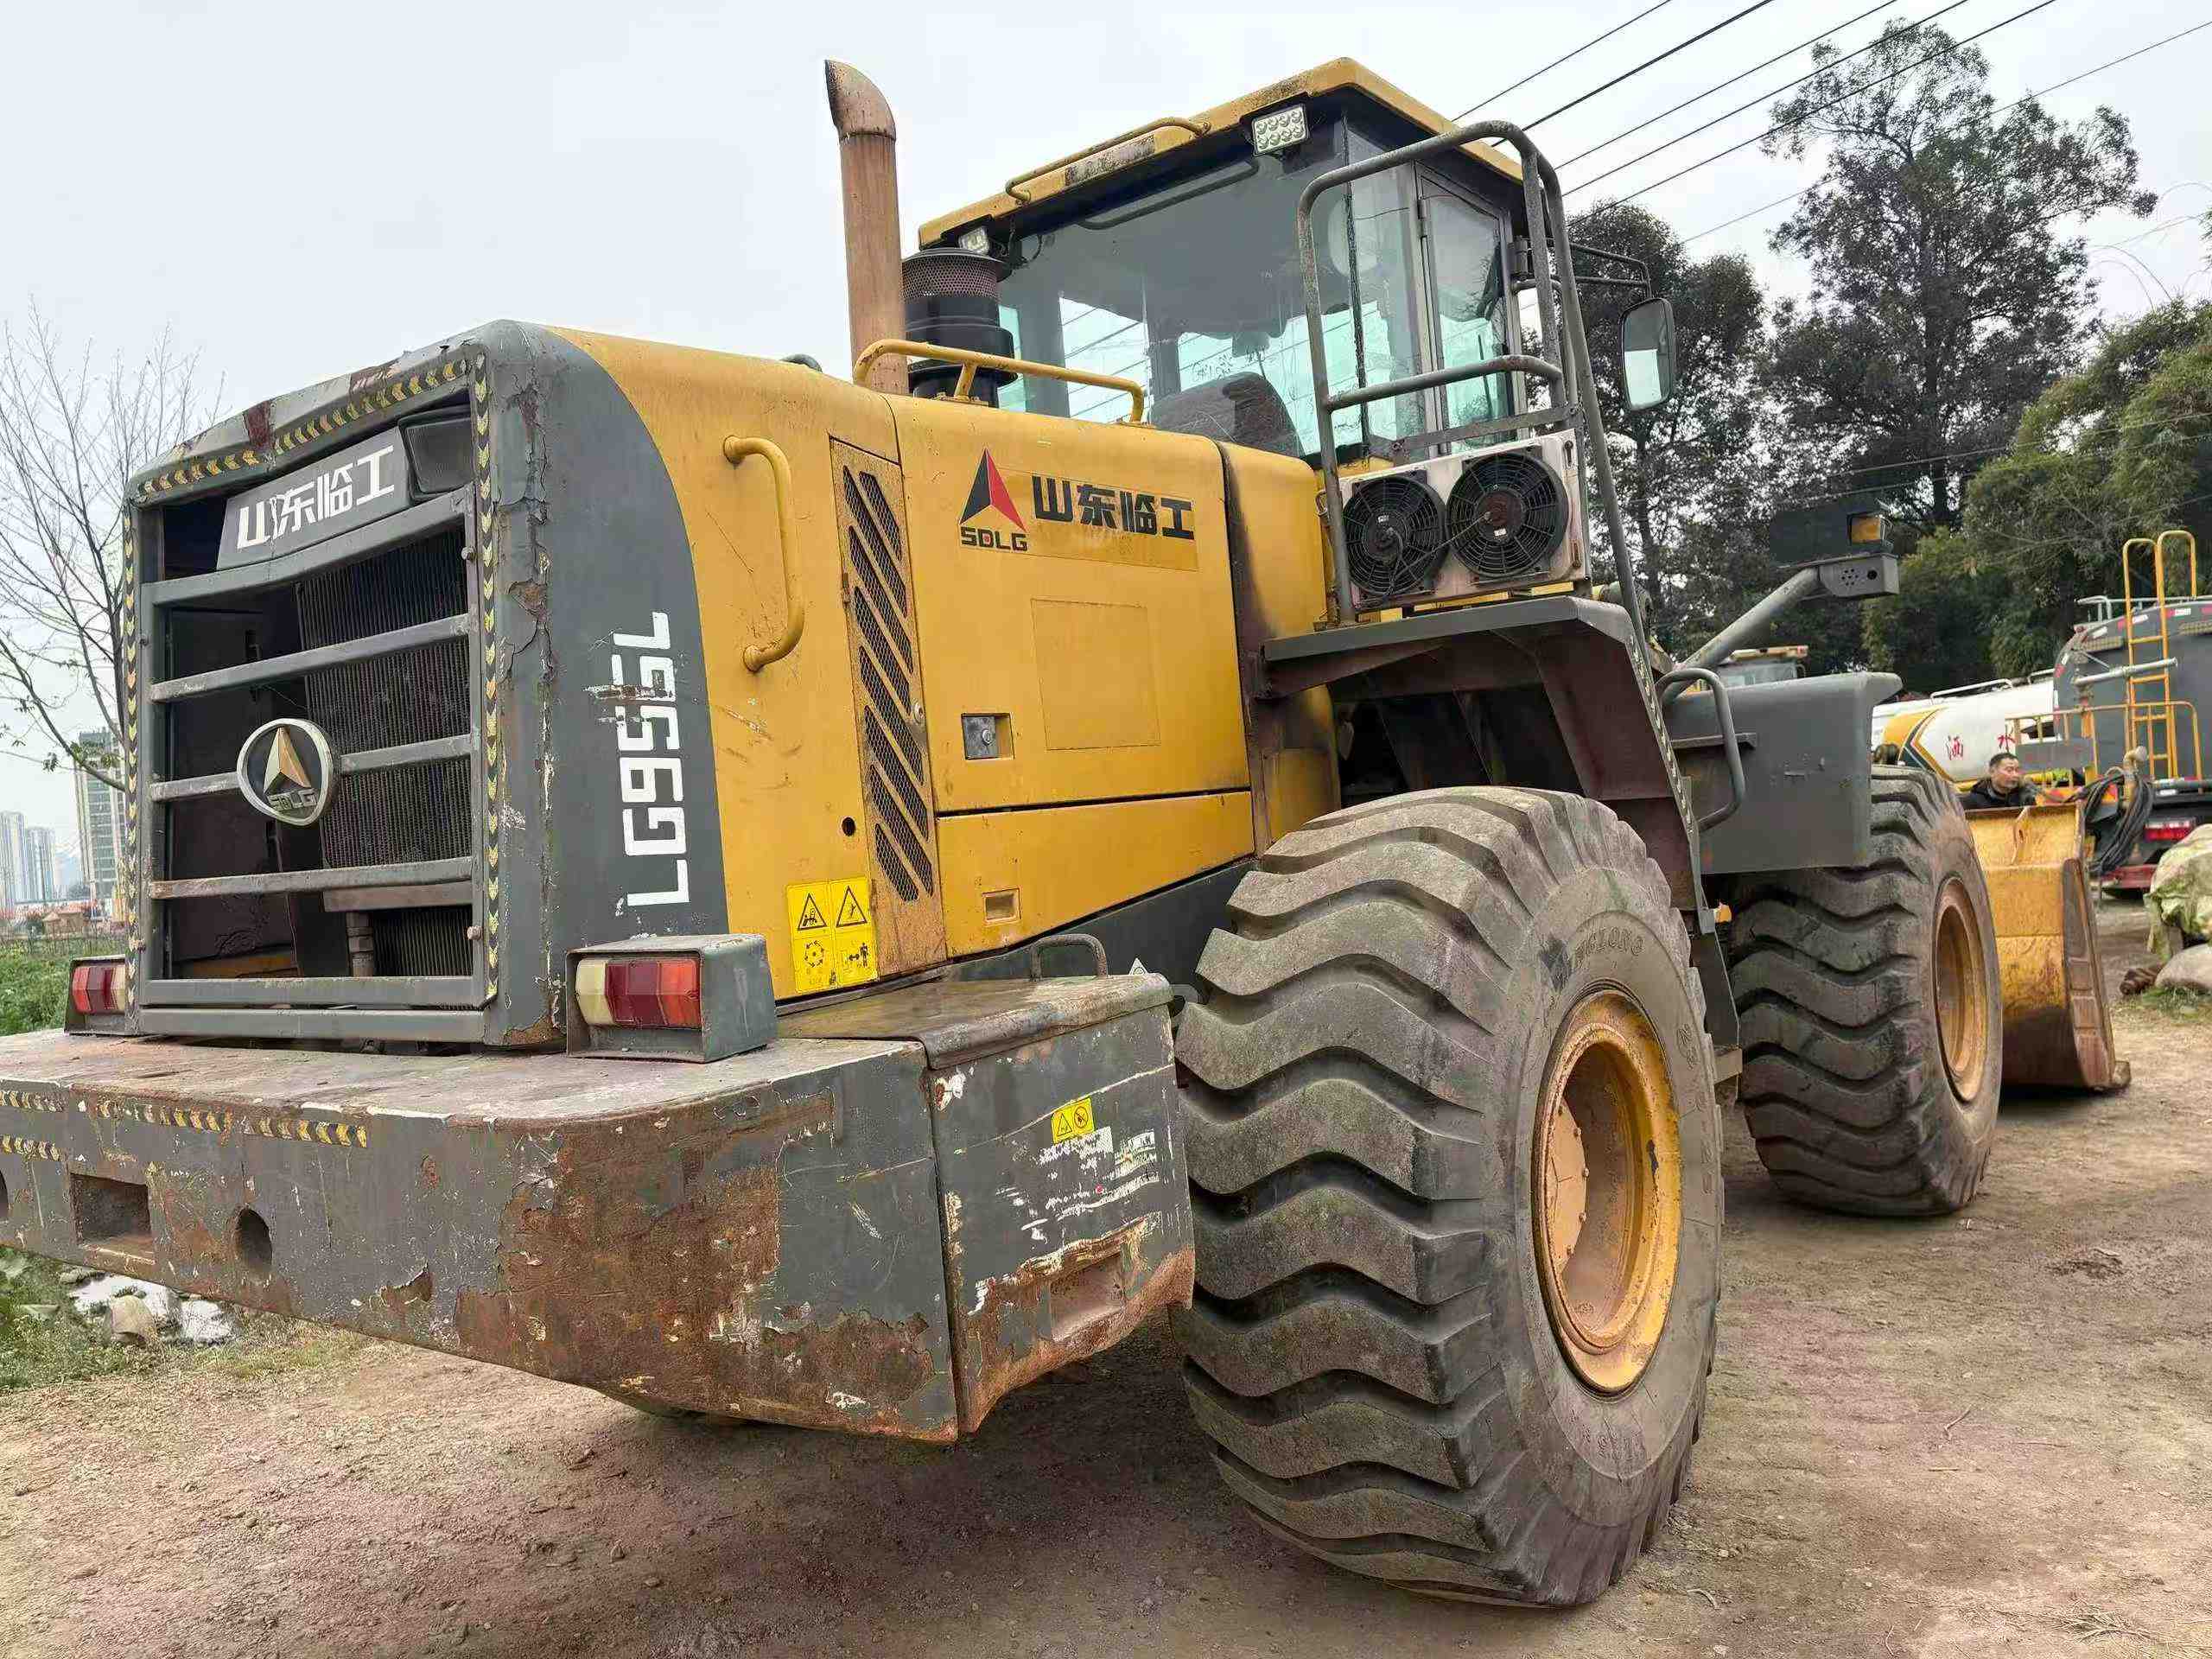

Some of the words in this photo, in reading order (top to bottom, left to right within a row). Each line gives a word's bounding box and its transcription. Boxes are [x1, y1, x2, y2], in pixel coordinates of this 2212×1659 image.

[236, 444, 396, 550] 山东临工
[1031, 475, 1195, 541] 山东临工
[959, 525, 1029, 552] SDLG
[611, 610, 690, 906] LG956L
[267, 787, 318, 813] SDLG
